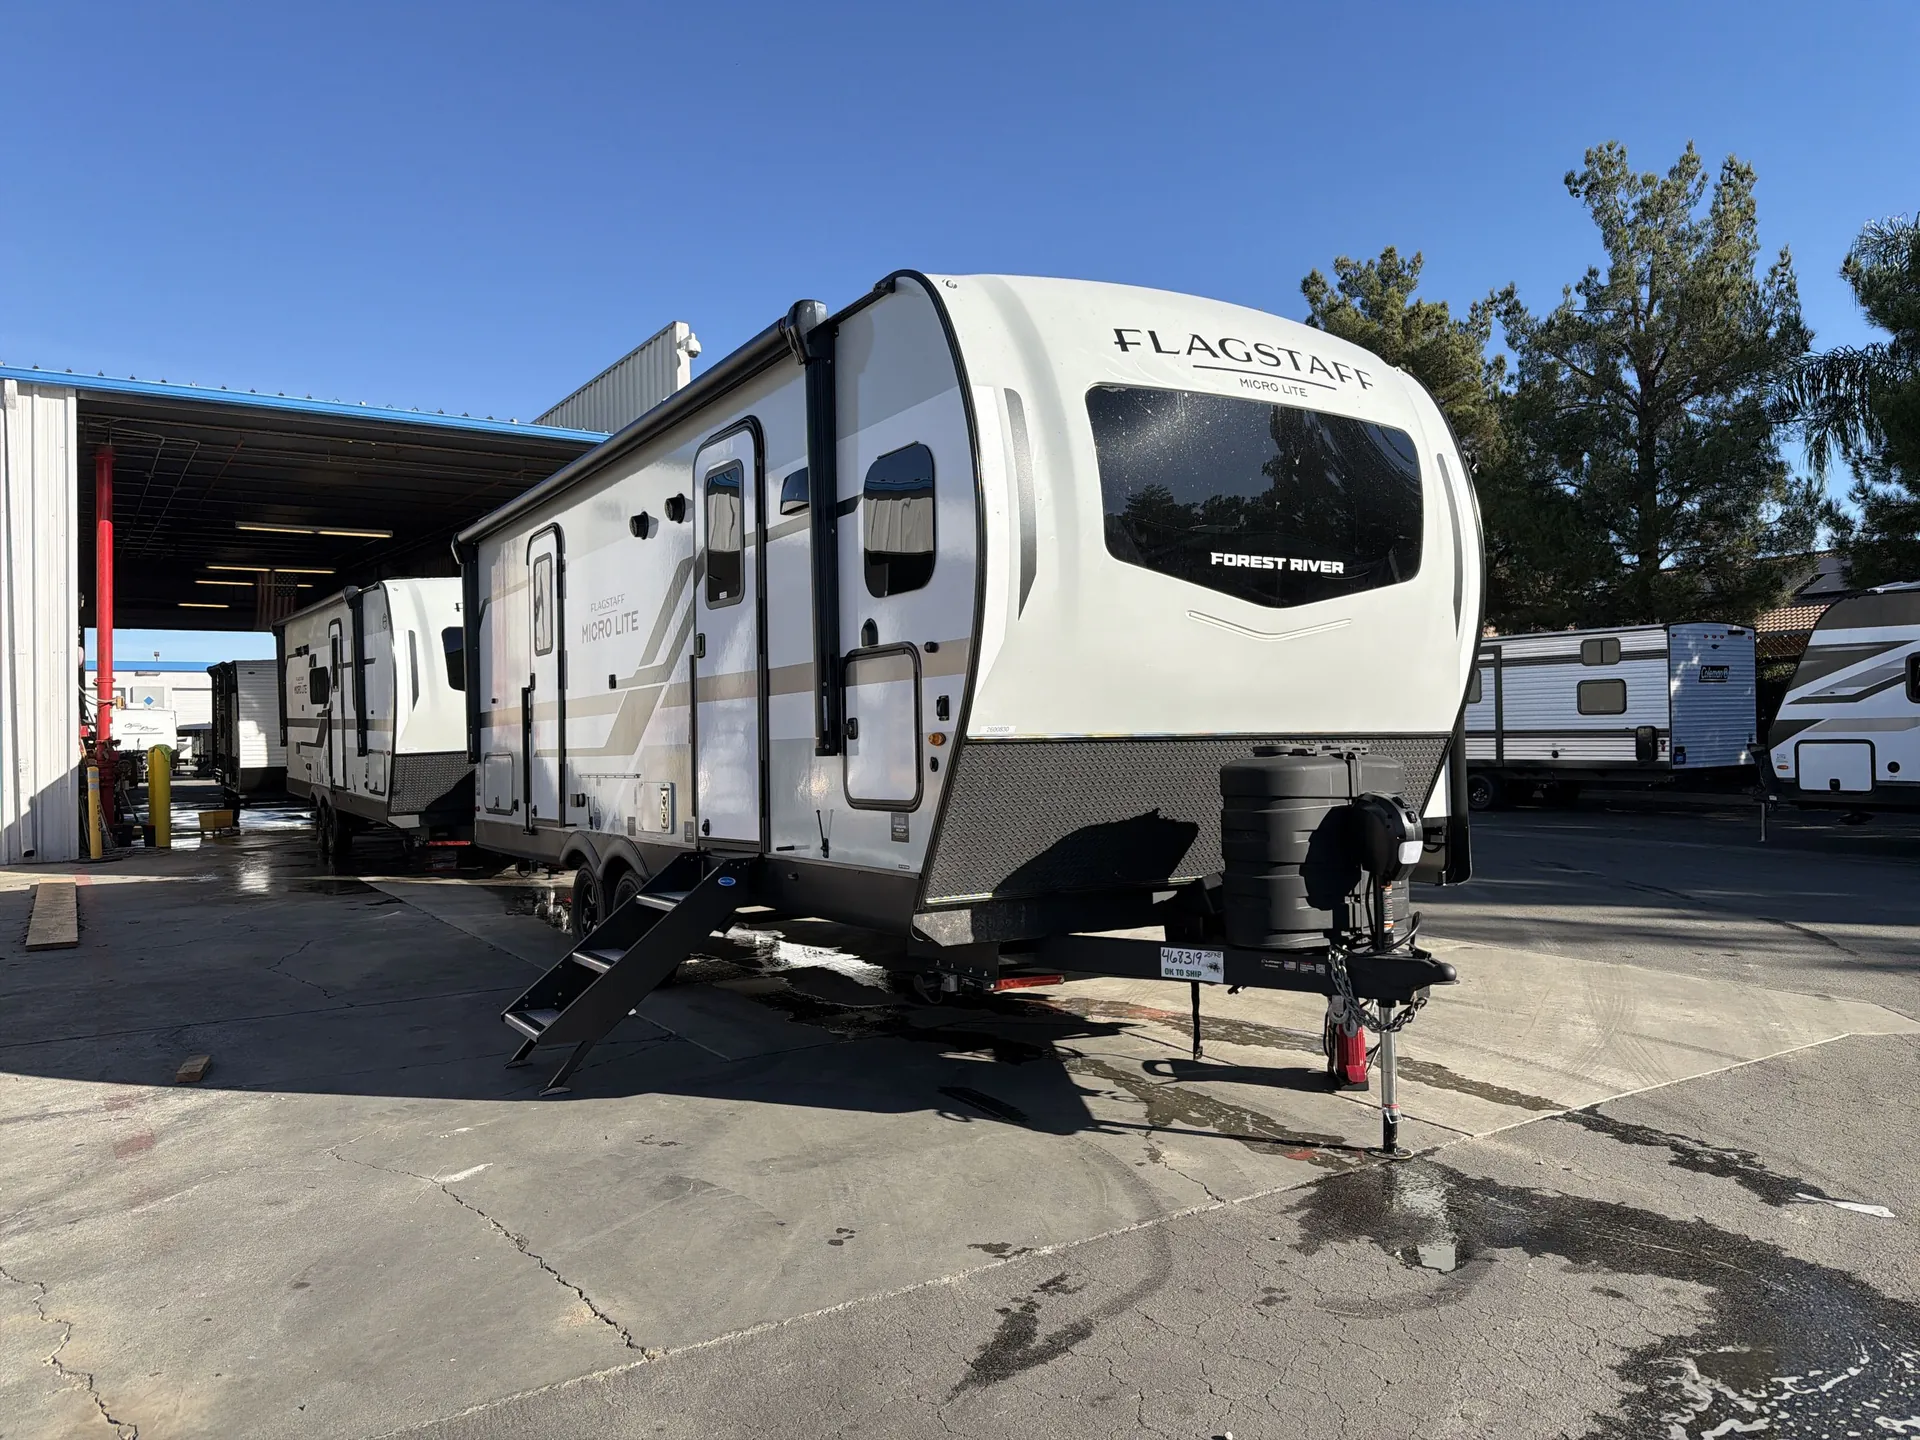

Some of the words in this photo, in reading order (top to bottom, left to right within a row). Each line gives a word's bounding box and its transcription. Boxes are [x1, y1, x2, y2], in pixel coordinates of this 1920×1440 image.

[1113, 328, 1374, 390] FLAGSTAFF
[1239, 377, 1279, 392] MICRO
[1282, 384, 1308, 398] LITE
[1210, 552, 1286, 570] FOREST
[1289, 558, 1344, 574] RIVER
[590, 593, 625, 612] FLAGSTAFF
[581, 618, 612, 644] MICRO
[615, 610, 638, 635] LITE
[1162, 949, 1202, 965] 468319
[1164, 968, 1174, 976] OK
[1186, 970, 1202, 978] SHIP
